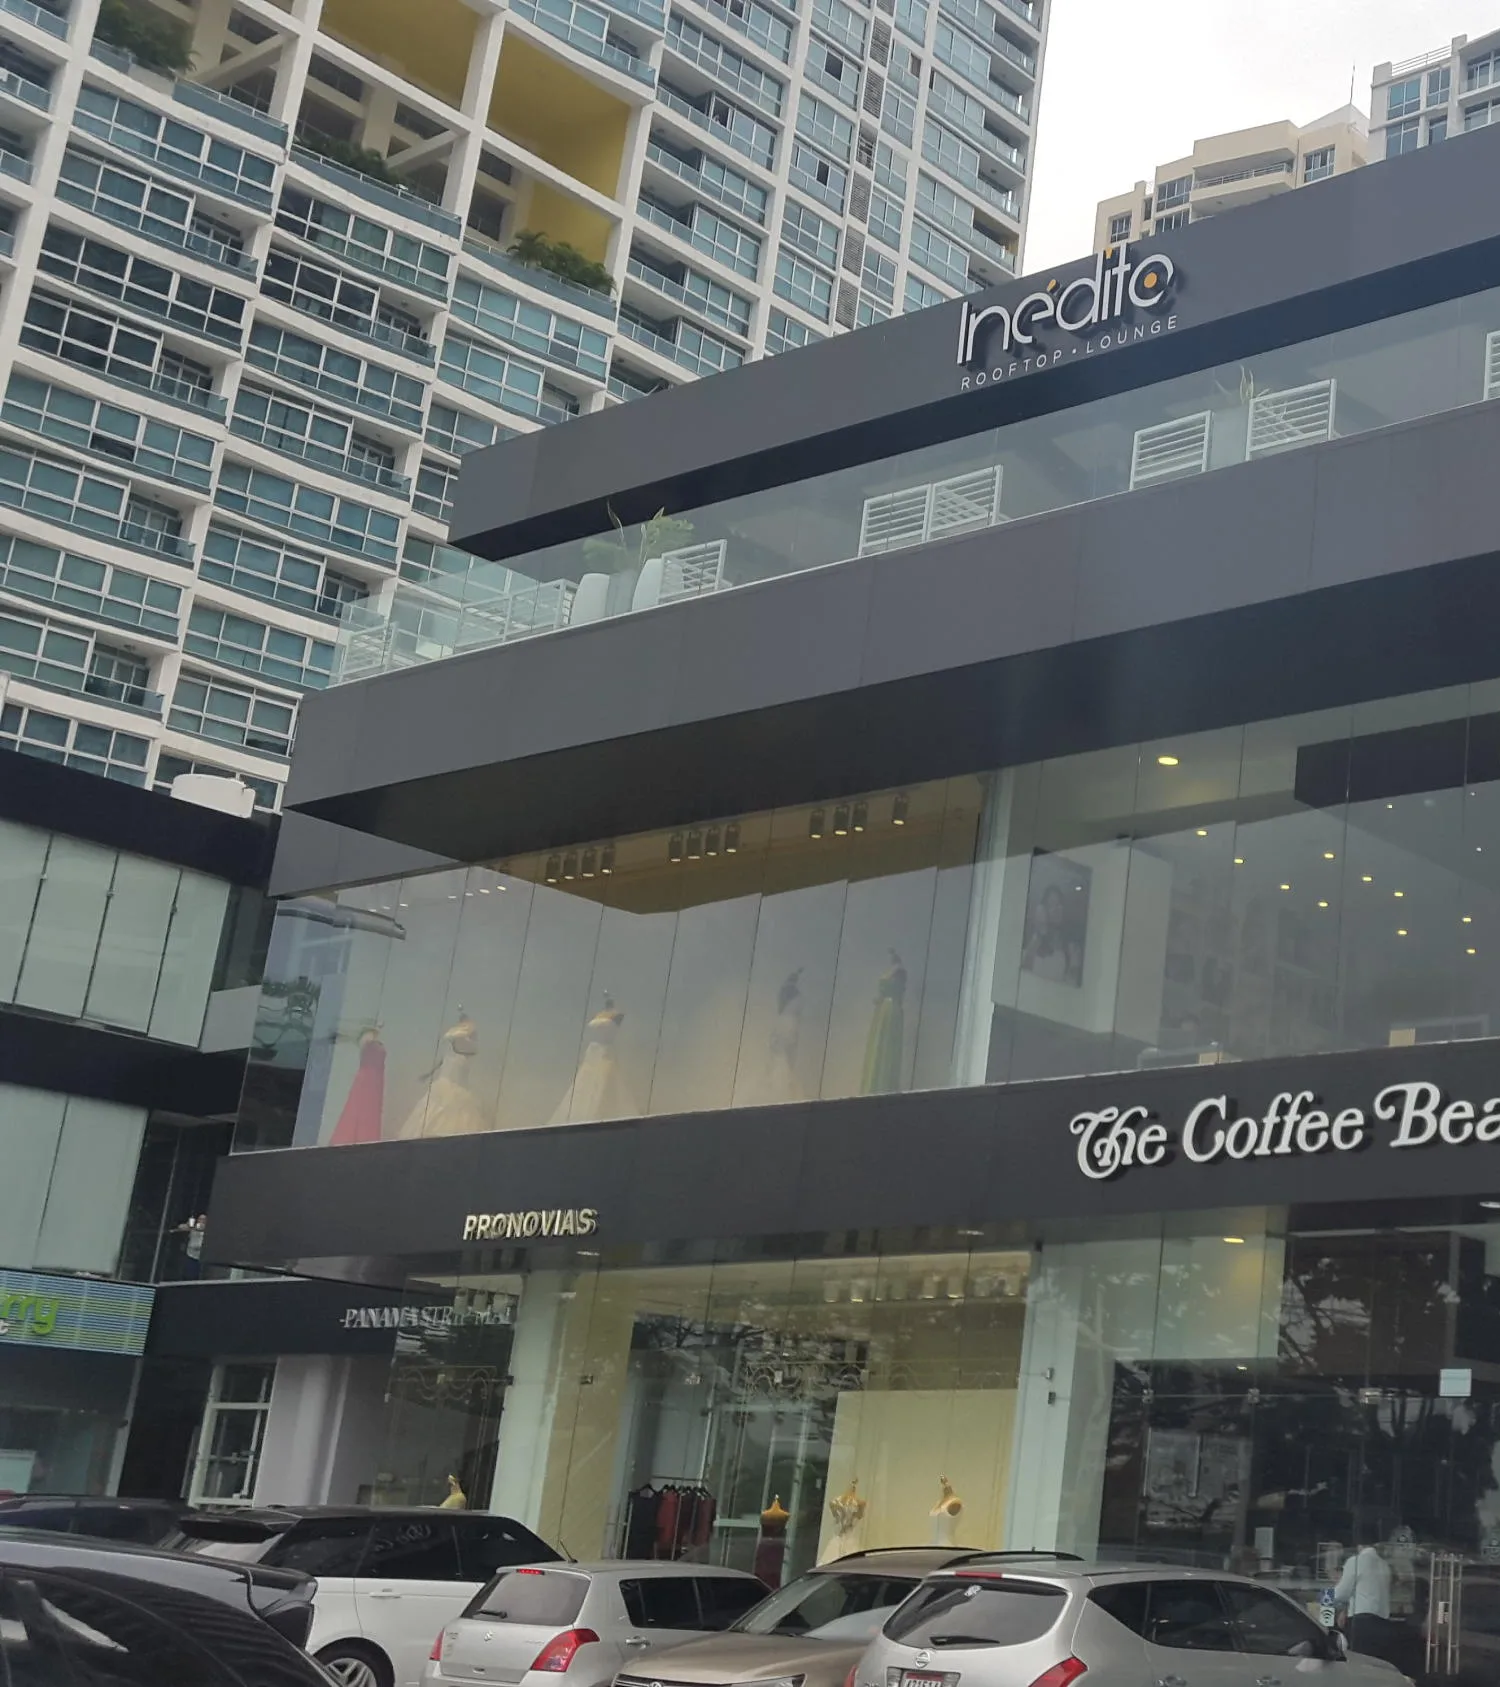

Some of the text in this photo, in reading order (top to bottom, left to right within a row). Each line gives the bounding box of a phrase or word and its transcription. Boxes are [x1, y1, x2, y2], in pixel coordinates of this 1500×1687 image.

[960, 315, 1178, 390] ROOFTOP LOUNGE
[1070, 1105, 1168, 1180] The
[1182, 1090, 1364, 1163] Coffee
[463, 1208, 599, 1241] PRONOVIAS
